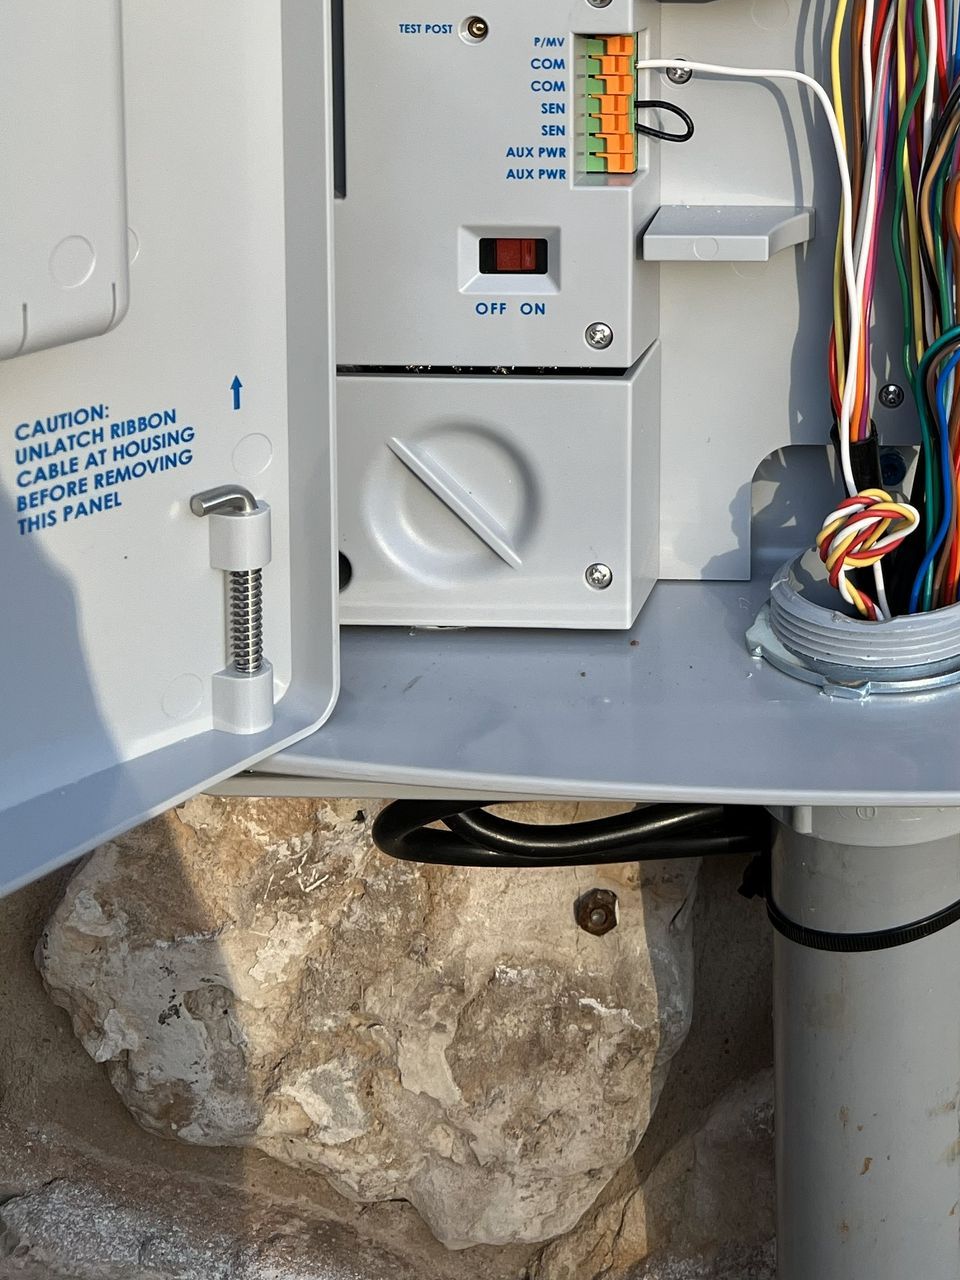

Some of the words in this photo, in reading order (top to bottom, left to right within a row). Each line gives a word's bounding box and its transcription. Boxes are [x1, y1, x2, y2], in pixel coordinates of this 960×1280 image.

[399, 23, 422, 34] TEST
[424, 23, 453, 34] POST
[534, 36, 565, 47] P/MV
[530, 58, 566, 70] COM
[531, 80, 566, 92] COM
[541, 102, 566, 115] SEN
[541, 124, 566, 137] SEN
[506, 146, 534, 158] AUX
[538, 147, 566, 158] PWR
[506, 168, 534, 180] AUX
[538, 168, 566, 180] PWR
[475, 302, 507, 316] OFF
[520, 302, 546, 316] ON
[14, 404, 110, 441] CAUTION:
[15, 427, 105, 465] UNLATCH
[110, 408, 177, 441] RIBBON
[16, 457, 79, 488] CABLE
[85, 450, 107, 469] AT
[112, 427, 196, 463] HOUSING
[16, 478, 88, 512] BEFORE
[94, 450, 194, 489] REMOVING
[17, 510, 58, 536] THIS
[62, 492, 123, 521] PANEL
